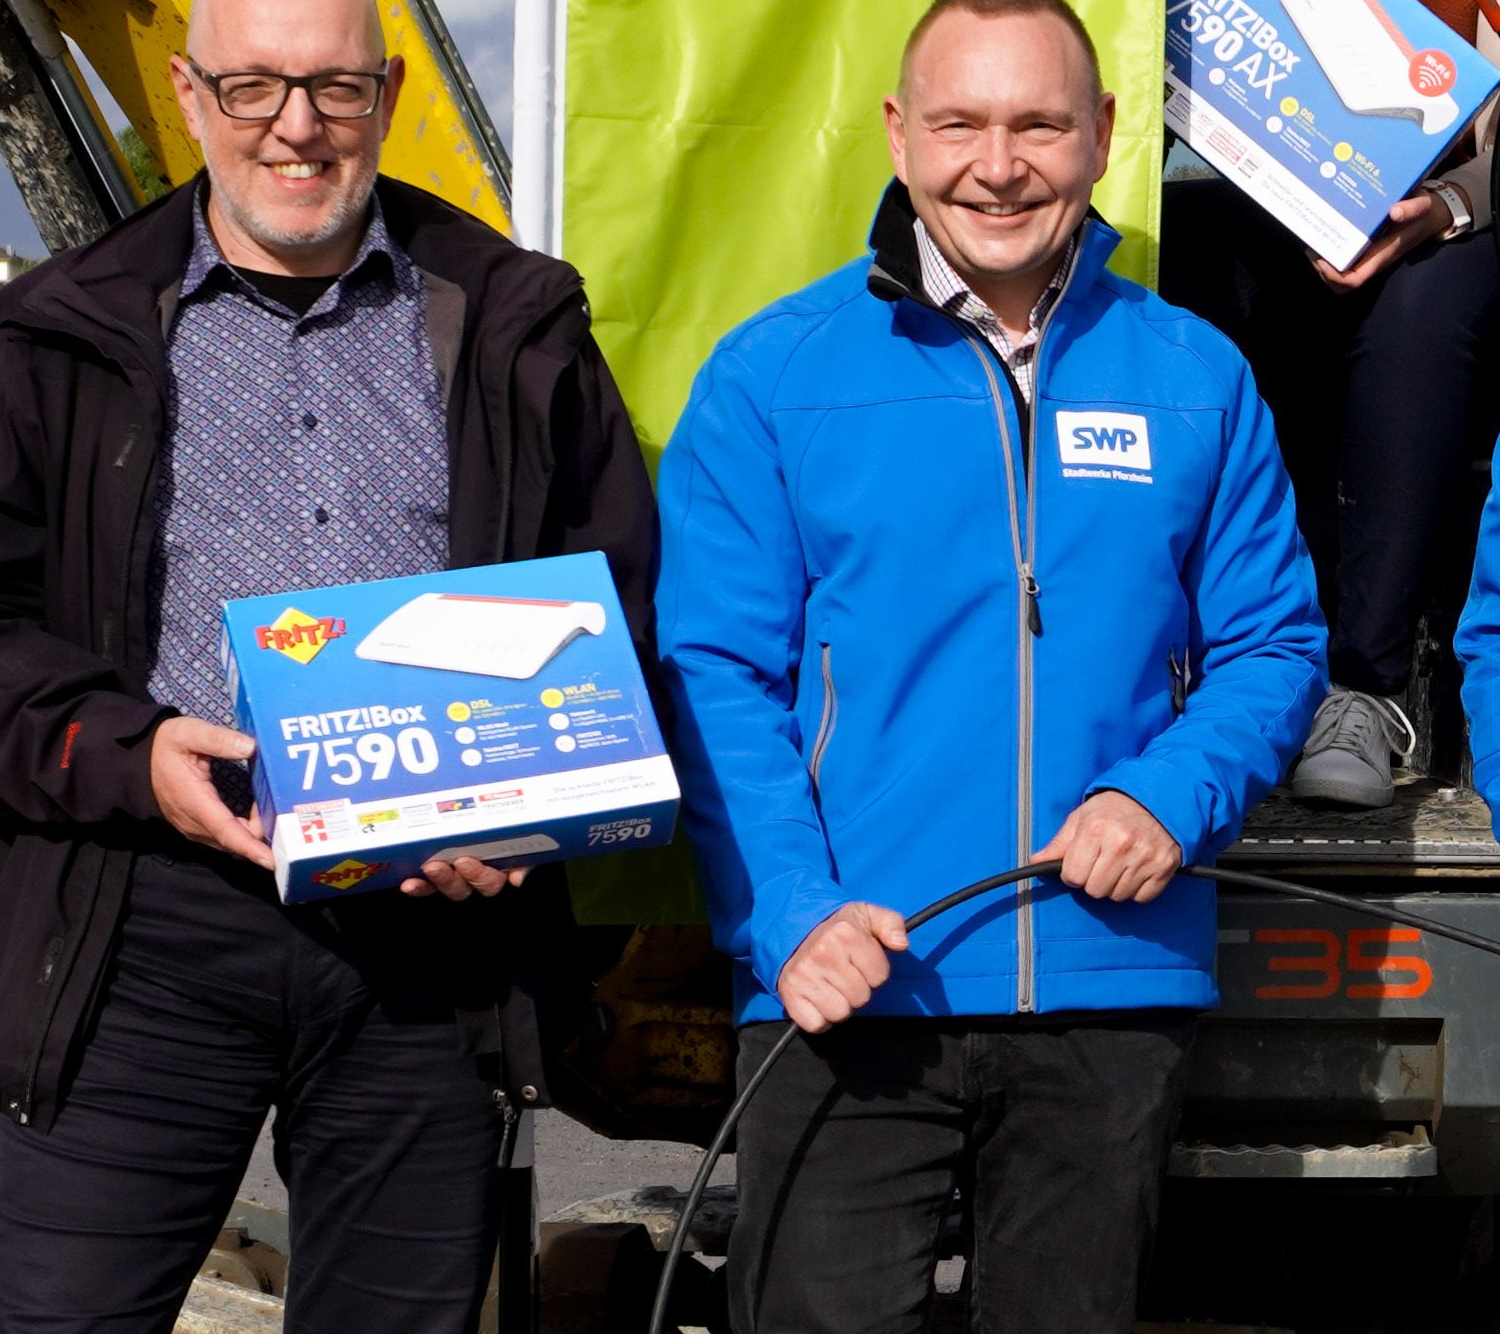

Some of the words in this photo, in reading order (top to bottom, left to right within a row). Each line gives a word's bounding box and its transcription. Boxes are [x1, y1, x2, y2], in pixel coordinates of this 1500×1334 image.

[1231, 51, 1289, 101] AX
[1072, 426, 1137, 453] SWP
[254, 616, 348, 653] FRITZ!
[279, 704, 428, 742] FRITZ!Box
[288, 727, 441, 792] 7590
[587, 823, 653, 847] 7590
